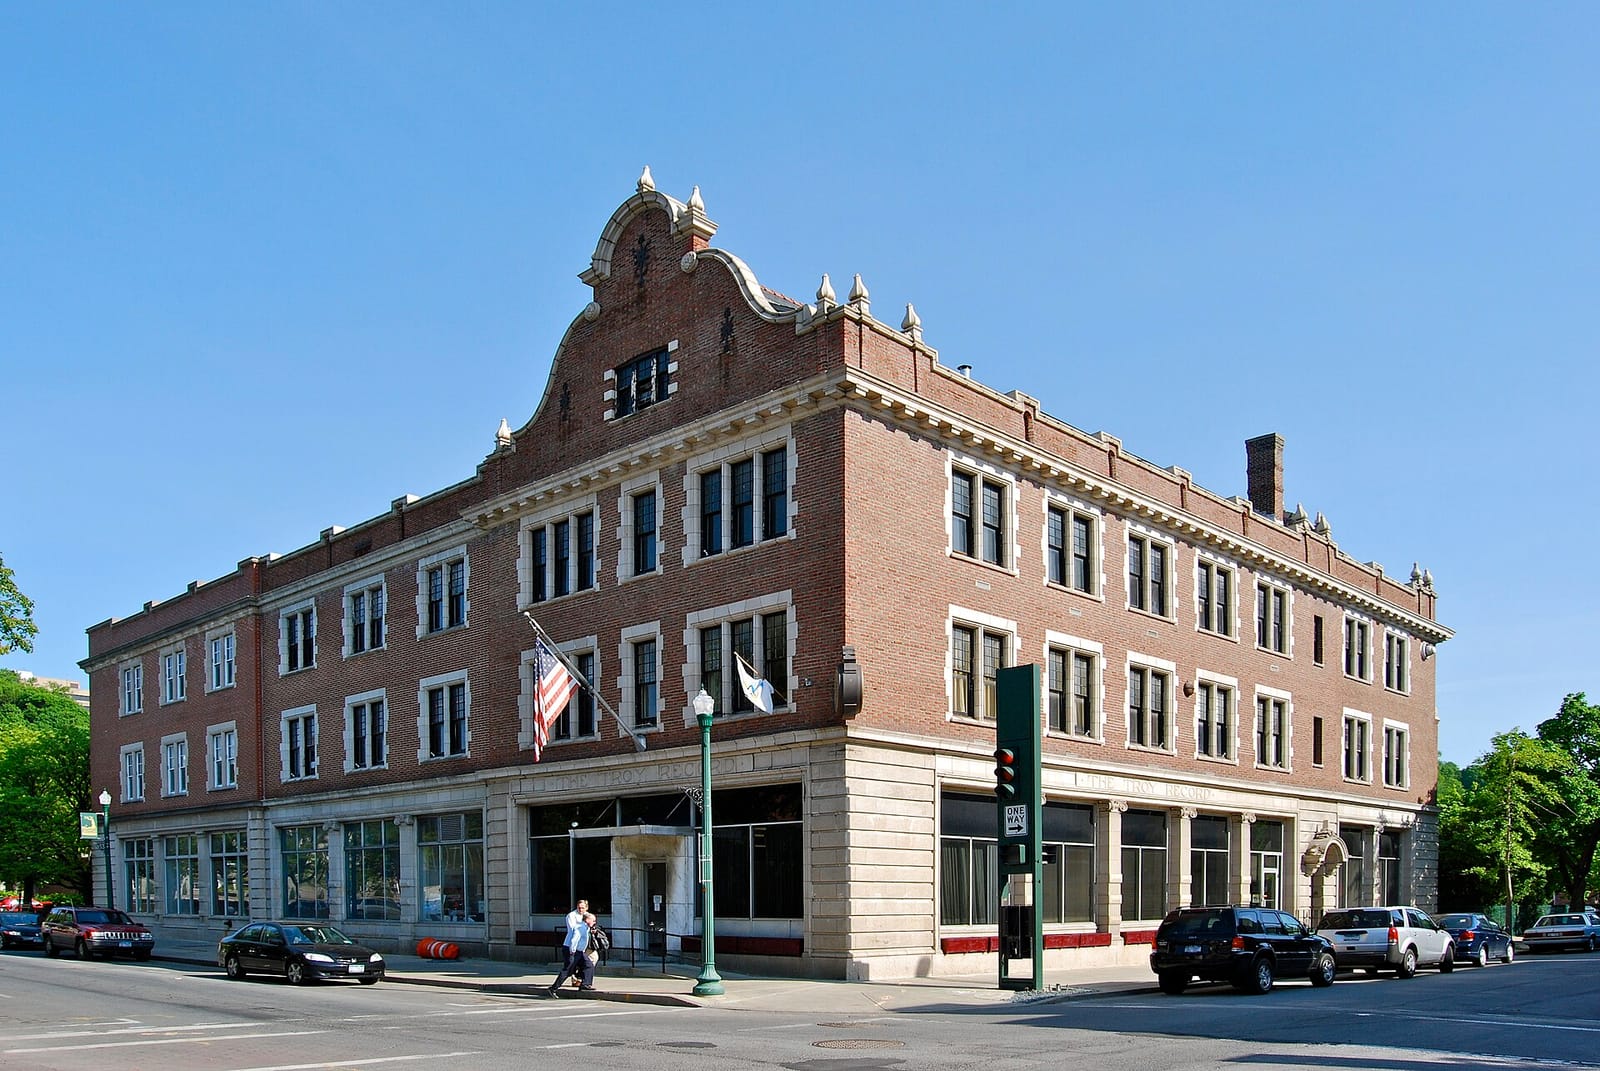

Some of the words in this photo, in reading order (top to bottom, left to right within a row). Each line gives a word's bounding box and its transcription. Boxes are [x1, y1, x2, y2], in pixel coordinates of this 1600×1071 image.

[555, 774, 588, 790] THE
[601, 767, 647, 784] TROY
[1087, 775, 1114, 789] THE
[1123, 779, 1156, 794] TROY
[1166, 783, 1211, 800] RECORD
[1007, 807, 1024, 815] ONE
[1007, 815, 1024, 823] WAY
